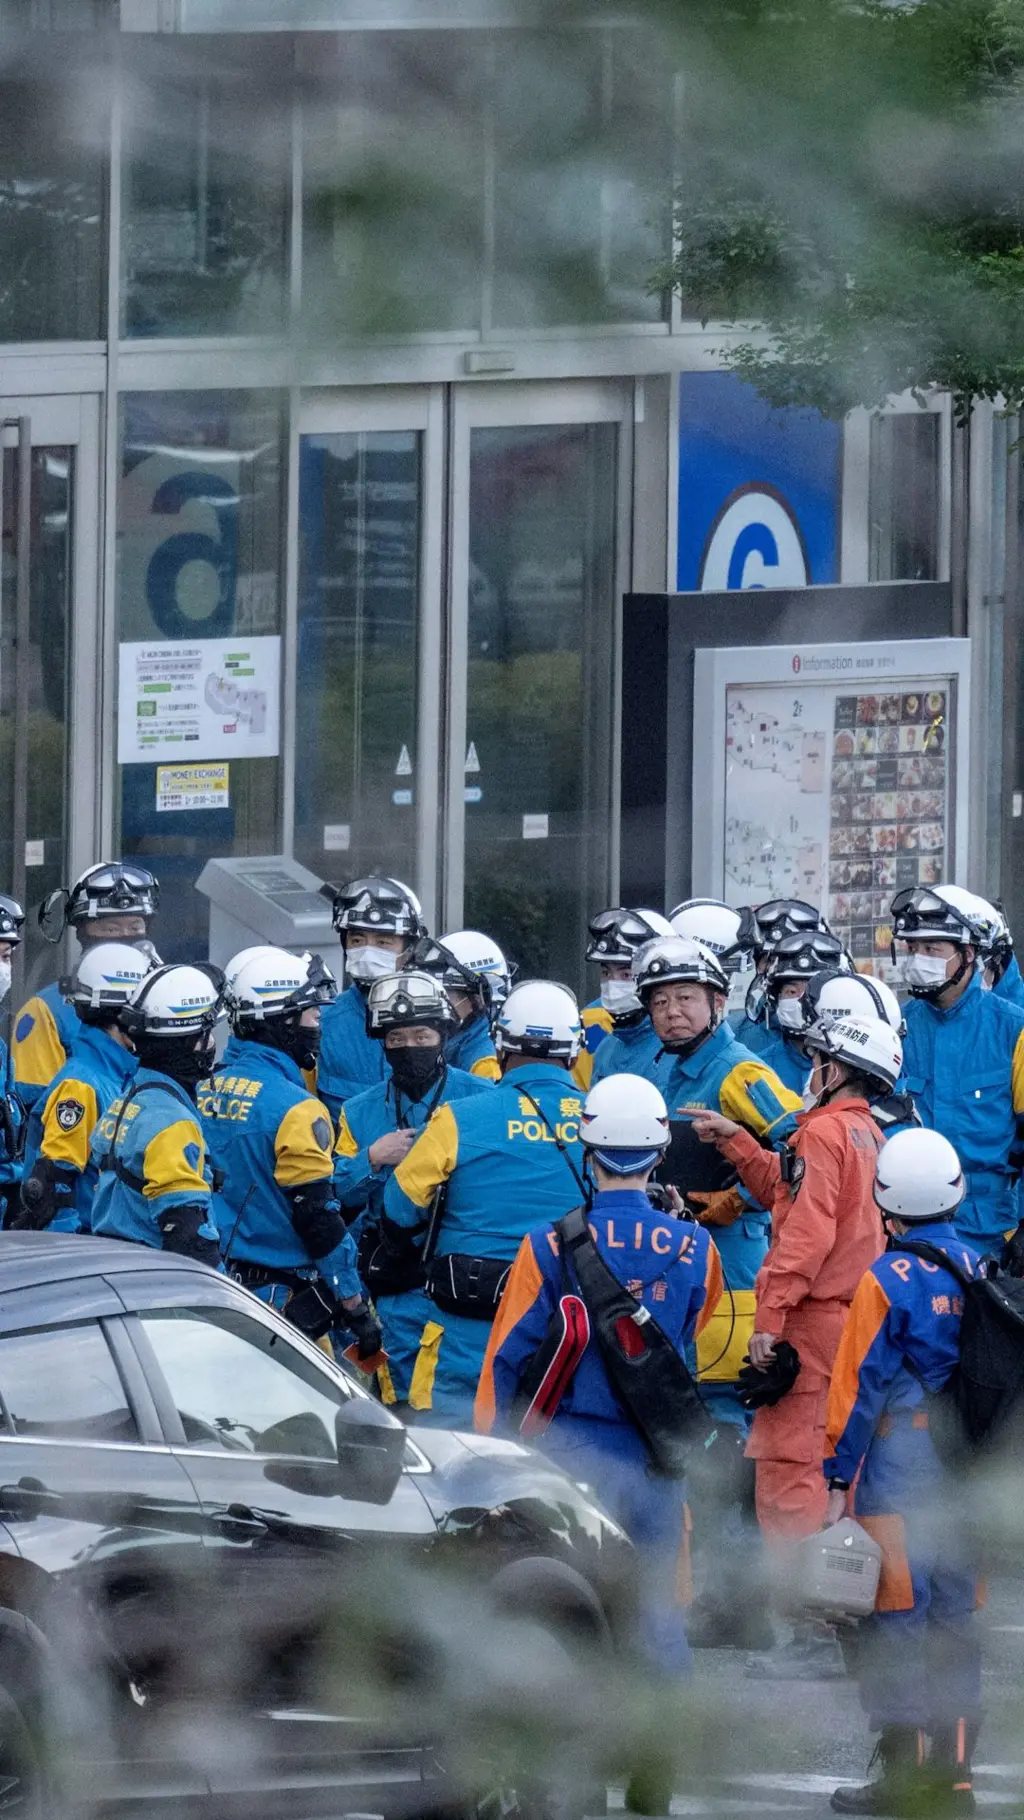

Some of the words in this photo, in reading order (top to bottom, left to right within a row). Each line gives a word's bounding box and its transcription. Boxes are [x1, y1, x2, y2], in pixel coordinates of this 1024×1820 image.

[803, 656, 853, 671] Information
[171, 770, 192, 780] MONEY
[194, 768, 225, 779] EXCHANGE
[507, 1119, 580, 1143] POLIC
